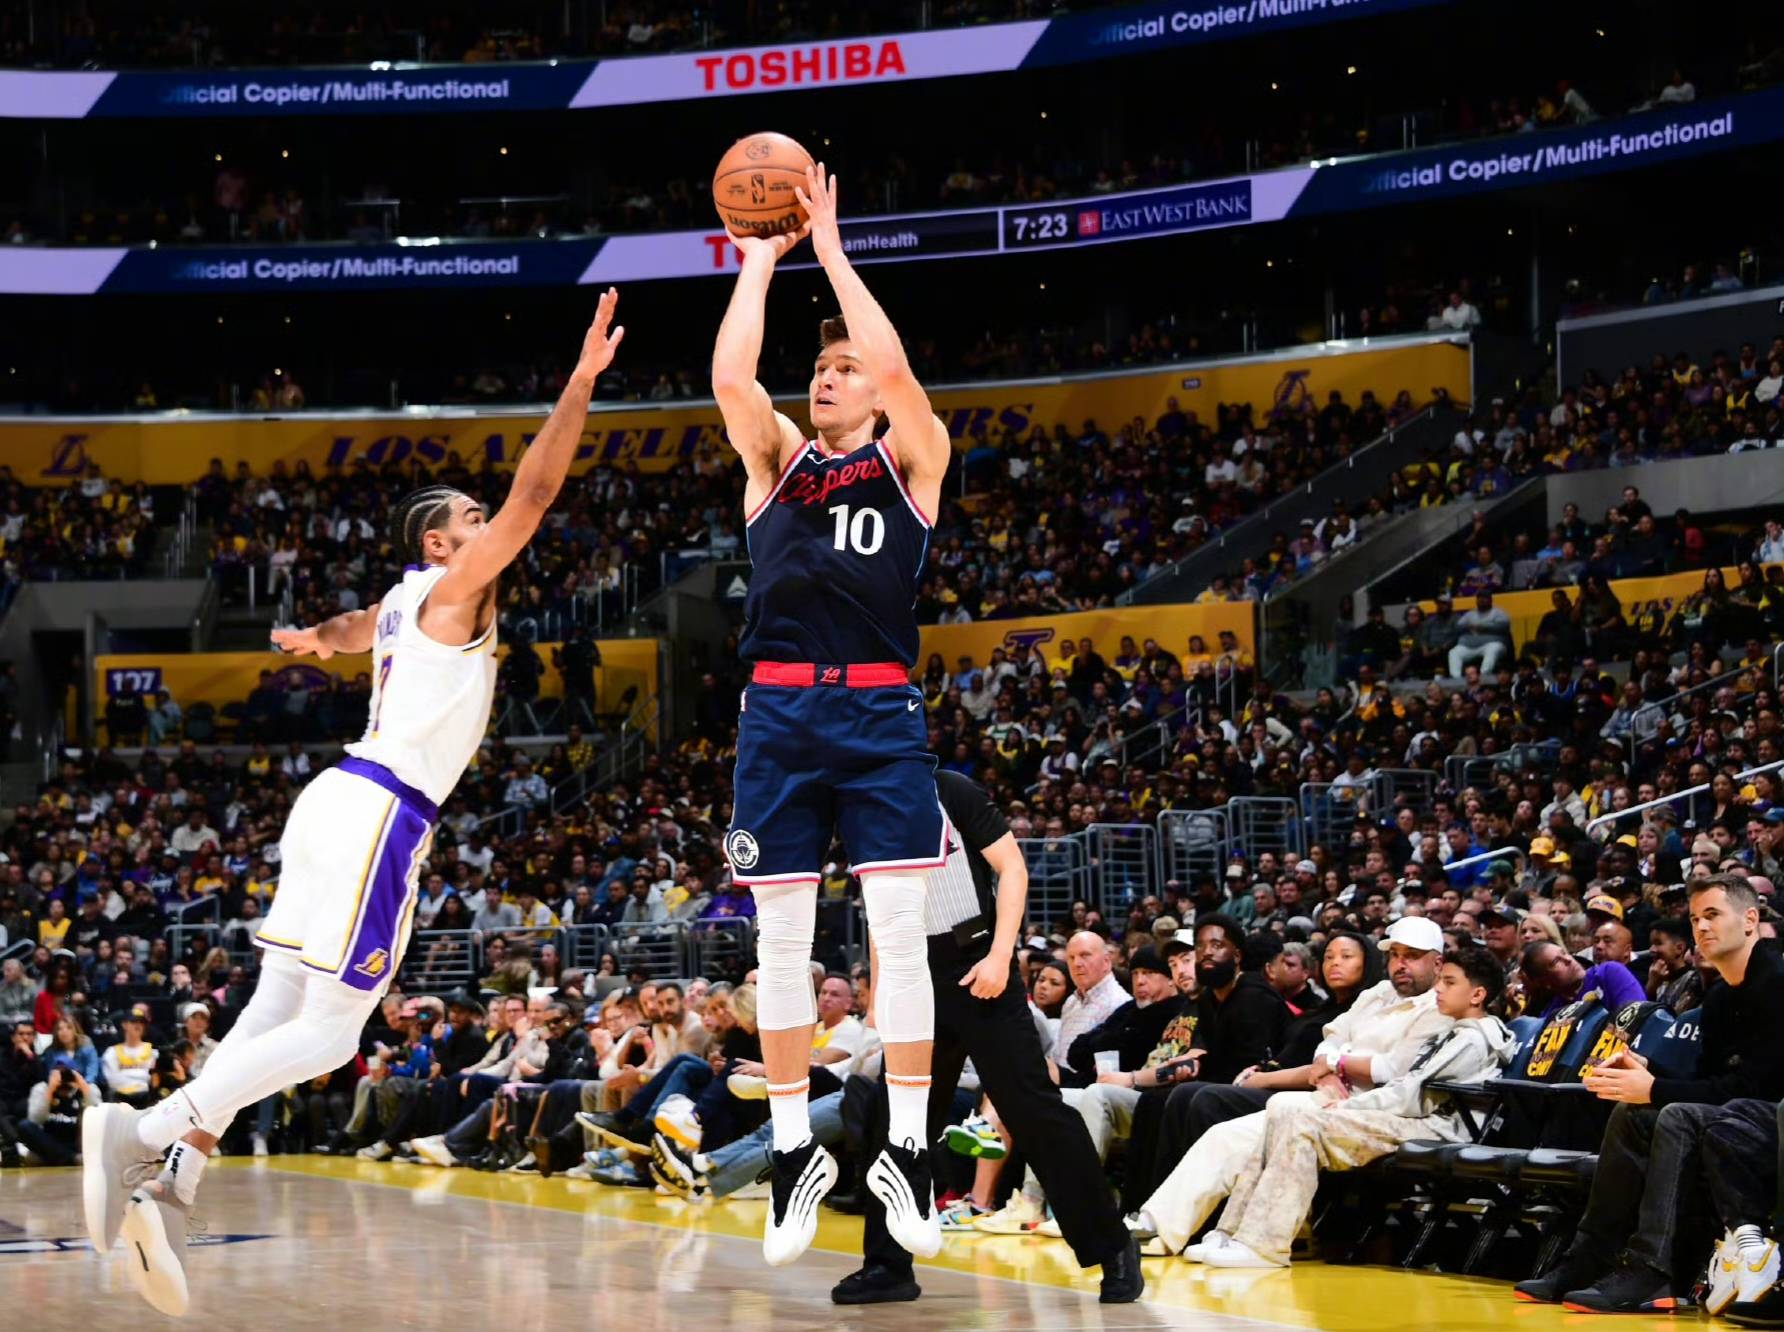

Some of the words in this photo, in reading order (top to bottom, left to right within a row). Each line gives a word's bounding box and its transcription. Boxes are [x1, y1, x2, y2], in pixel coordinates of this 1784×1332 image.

[695, 41, 906, 92] TOSHIBA
[244, 80, 510, 106] Copier/Multi-Functional
[1449, 112, 1733, 181] Copier/Multi-Functional
[842, 231, 919, 252] amHealth
[1013, 213, 1069, 241] 7:23
[254, 256, 519, 282] Copier/Multi-Functional
[778, 456, 885, 506] Clippers
[828, 504, 886, 556] 10
